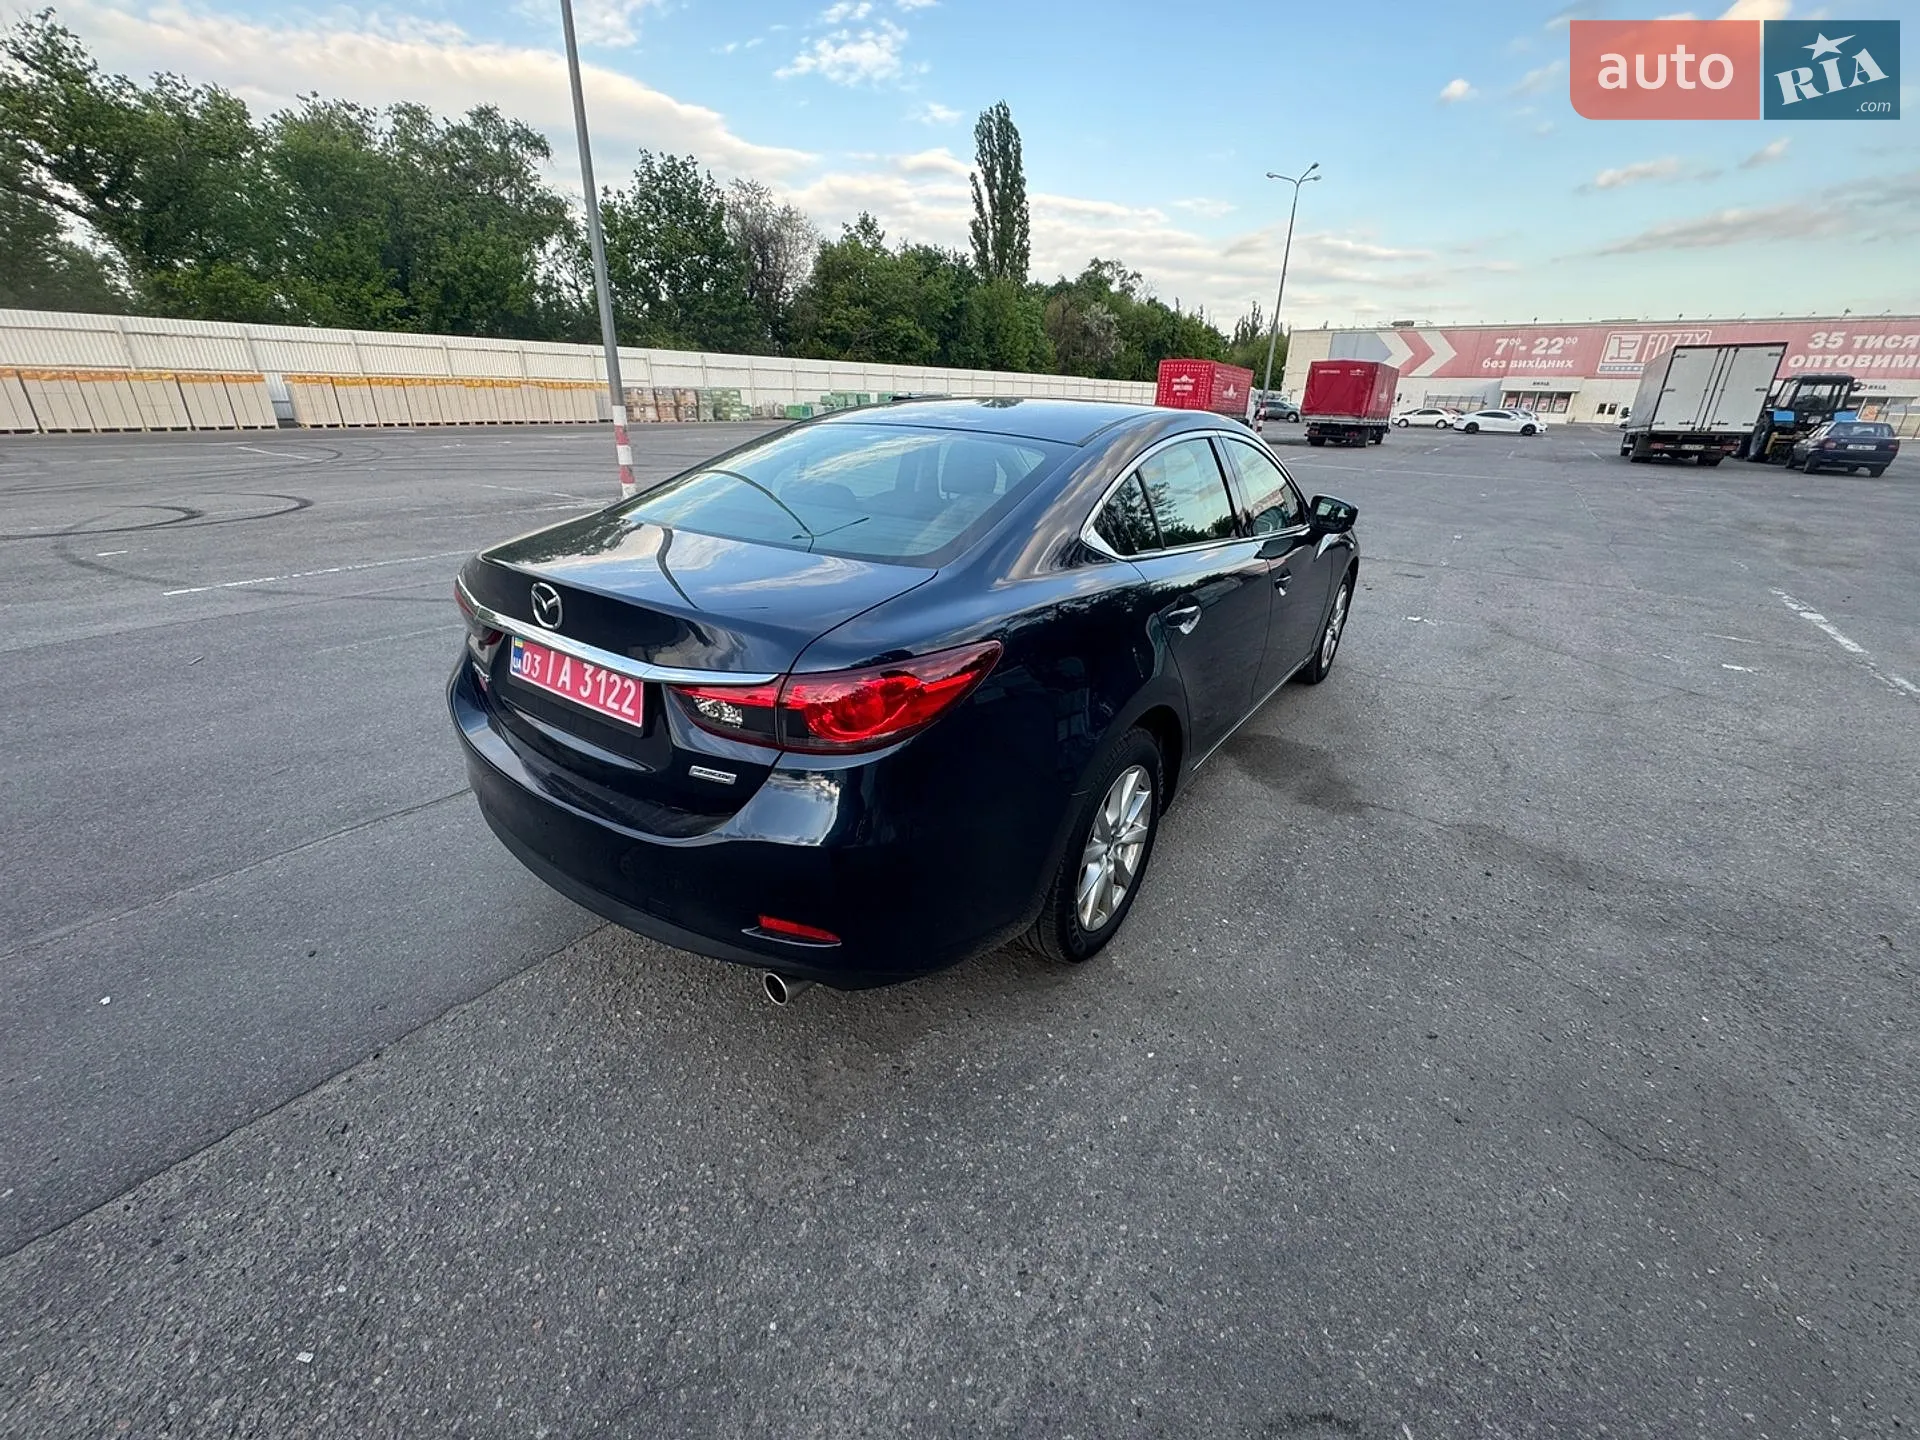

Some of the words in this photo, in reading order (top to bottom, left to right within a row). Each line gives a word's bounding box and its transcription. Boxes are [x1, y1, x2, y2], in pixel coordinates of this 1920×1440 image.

[1807, 331, 1846, 349] 35
[1482, 357, 1506, 369] без
[1510, 357, 1575, 369] вихідних
[522, 651, 541, 678] 03
[546, 650, 571, 691] IA
[579, 662, 636, 716] 3122
